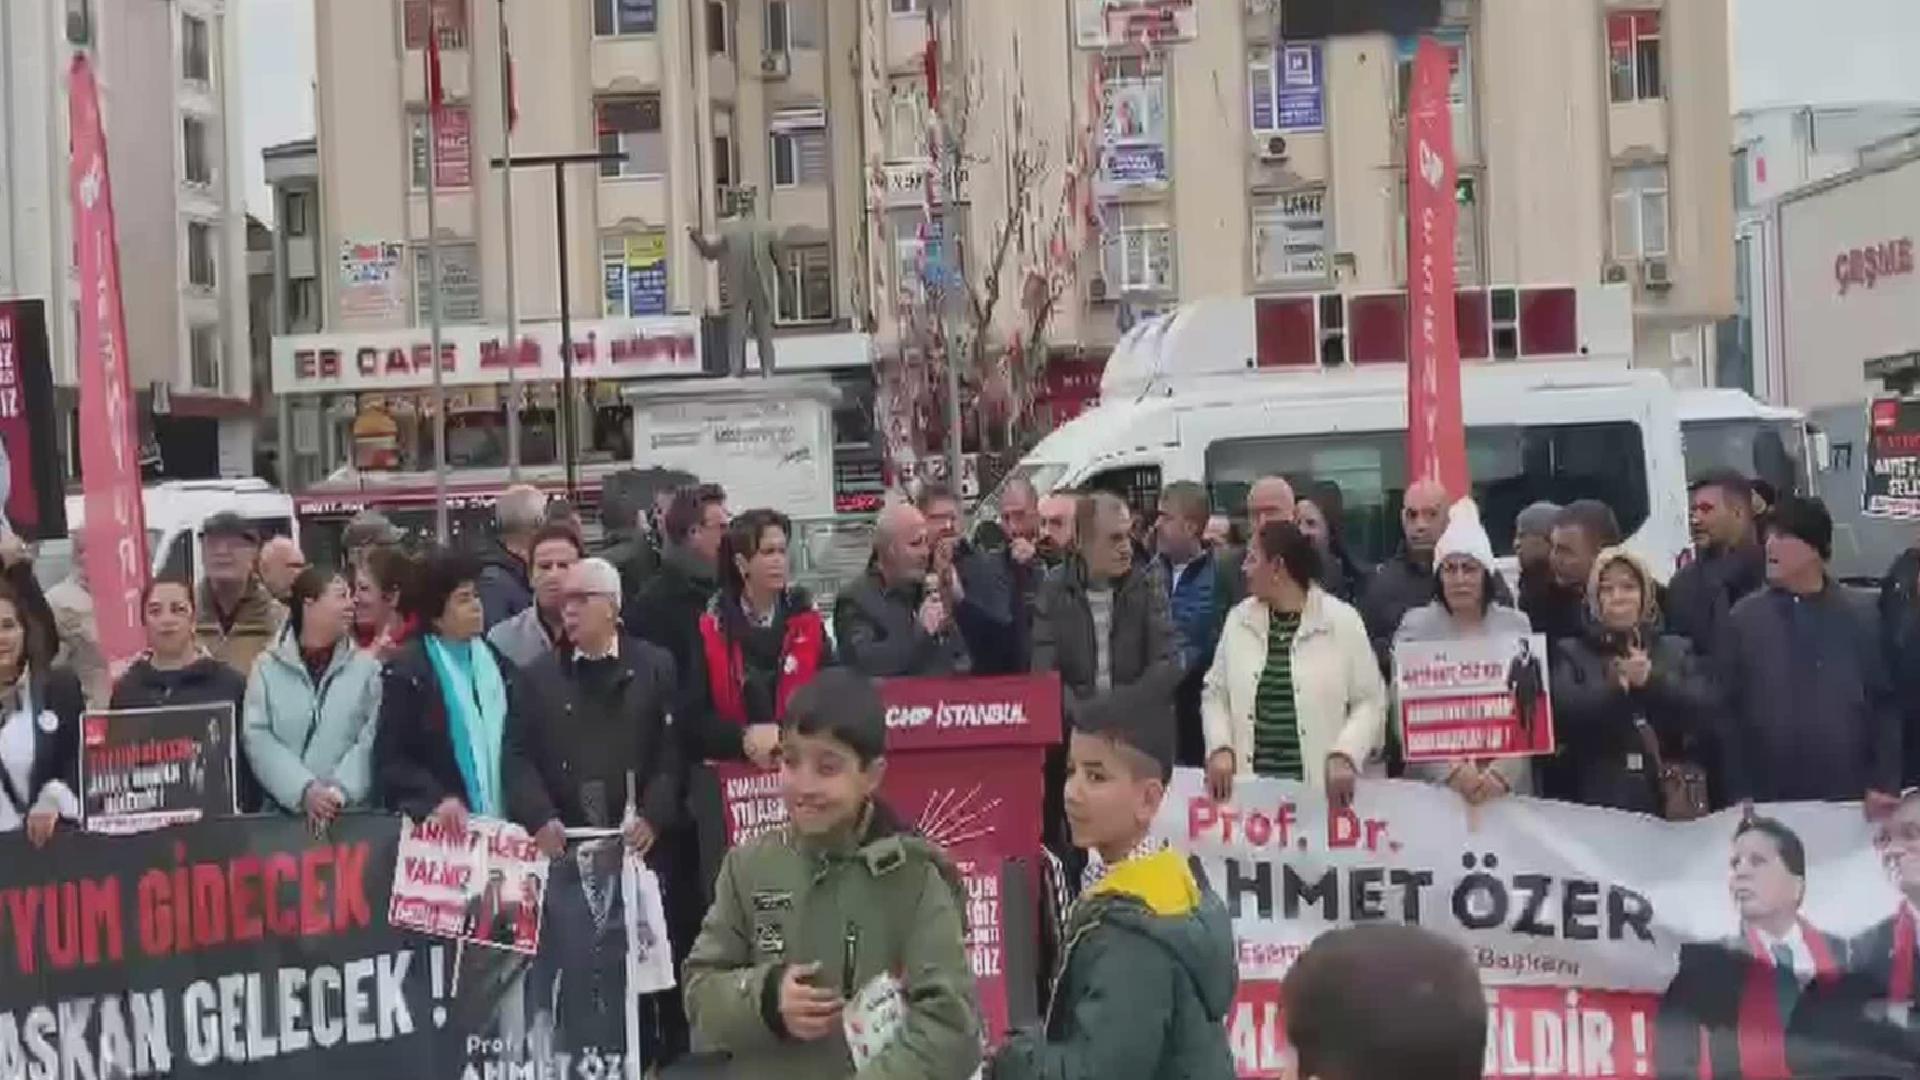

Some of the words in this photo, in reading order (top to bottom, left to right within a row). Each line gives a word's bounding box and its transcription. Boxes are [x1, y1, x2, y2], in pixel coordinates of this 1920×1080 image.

[1189, 797, 1308, 850] Prof.
[1327, 805, 1403, 851] Dr.
[137, 839, 369, 957] GİDECEK
[1451, 851, 1655, 946] ÖZER
[184, 949, 415, 1066] GELECEK
